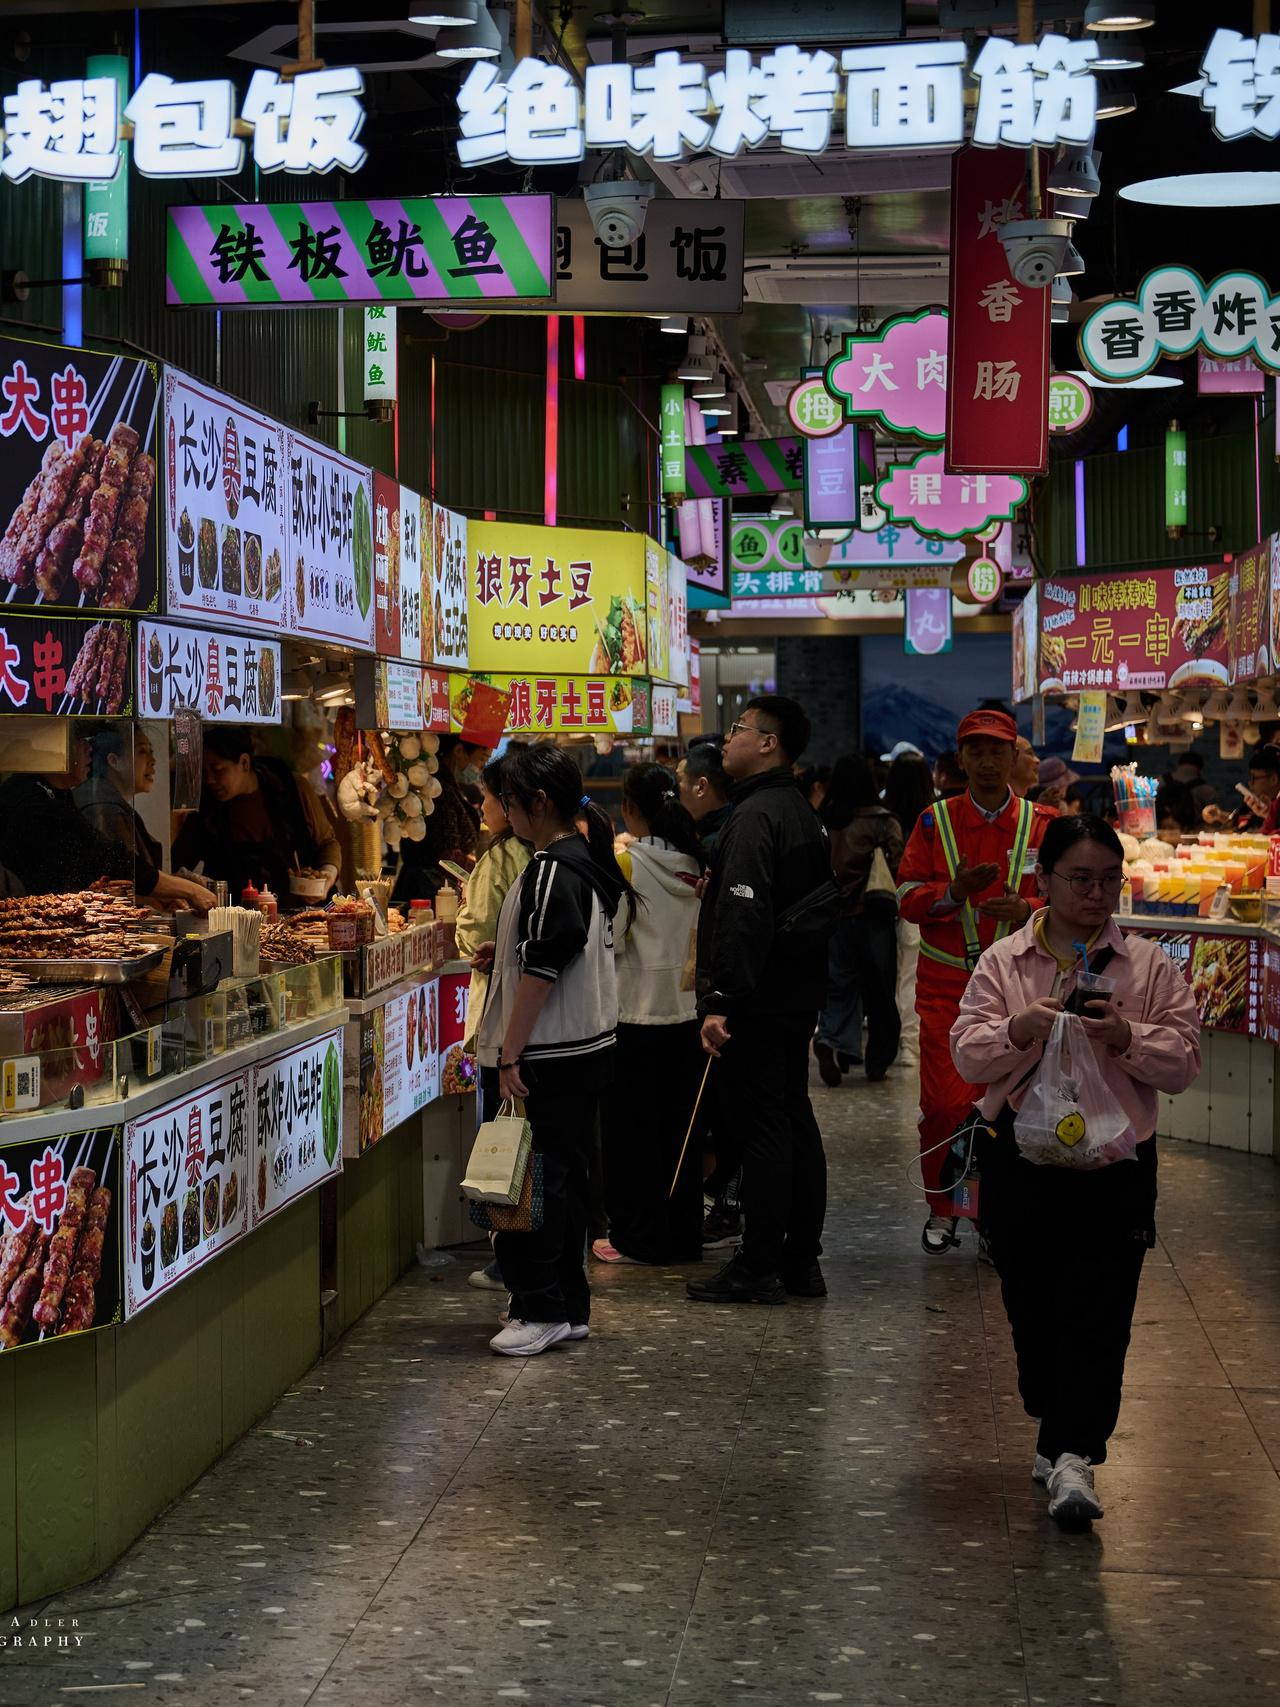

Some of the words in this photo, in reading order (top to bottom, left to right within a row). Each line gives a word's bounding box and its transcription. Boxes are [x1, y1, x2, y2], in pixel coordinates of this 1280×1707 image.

[456, 34, 1100, 168] 绝味烤面筋
[210, 215, 504, 284] 铁板鱿鱼
[179, 403, 277, 515] 长沙臭豆腐
[664, 398, 681, 478] 小土豆
[909, 474, 992, 505] 果汁
[474, 550, 595, 611] 狼牙土豆
[1078, 577, 1157, 613] 川味棒棒鸡
[1065, 612, 1170, 666] 一元一串
[165, 633, 258, 716] 长沙臭豆腐
[509, 678, 608, 729] 狼牙土豆
[137, 1073, 246, 1217] 长沙臭豆腐
